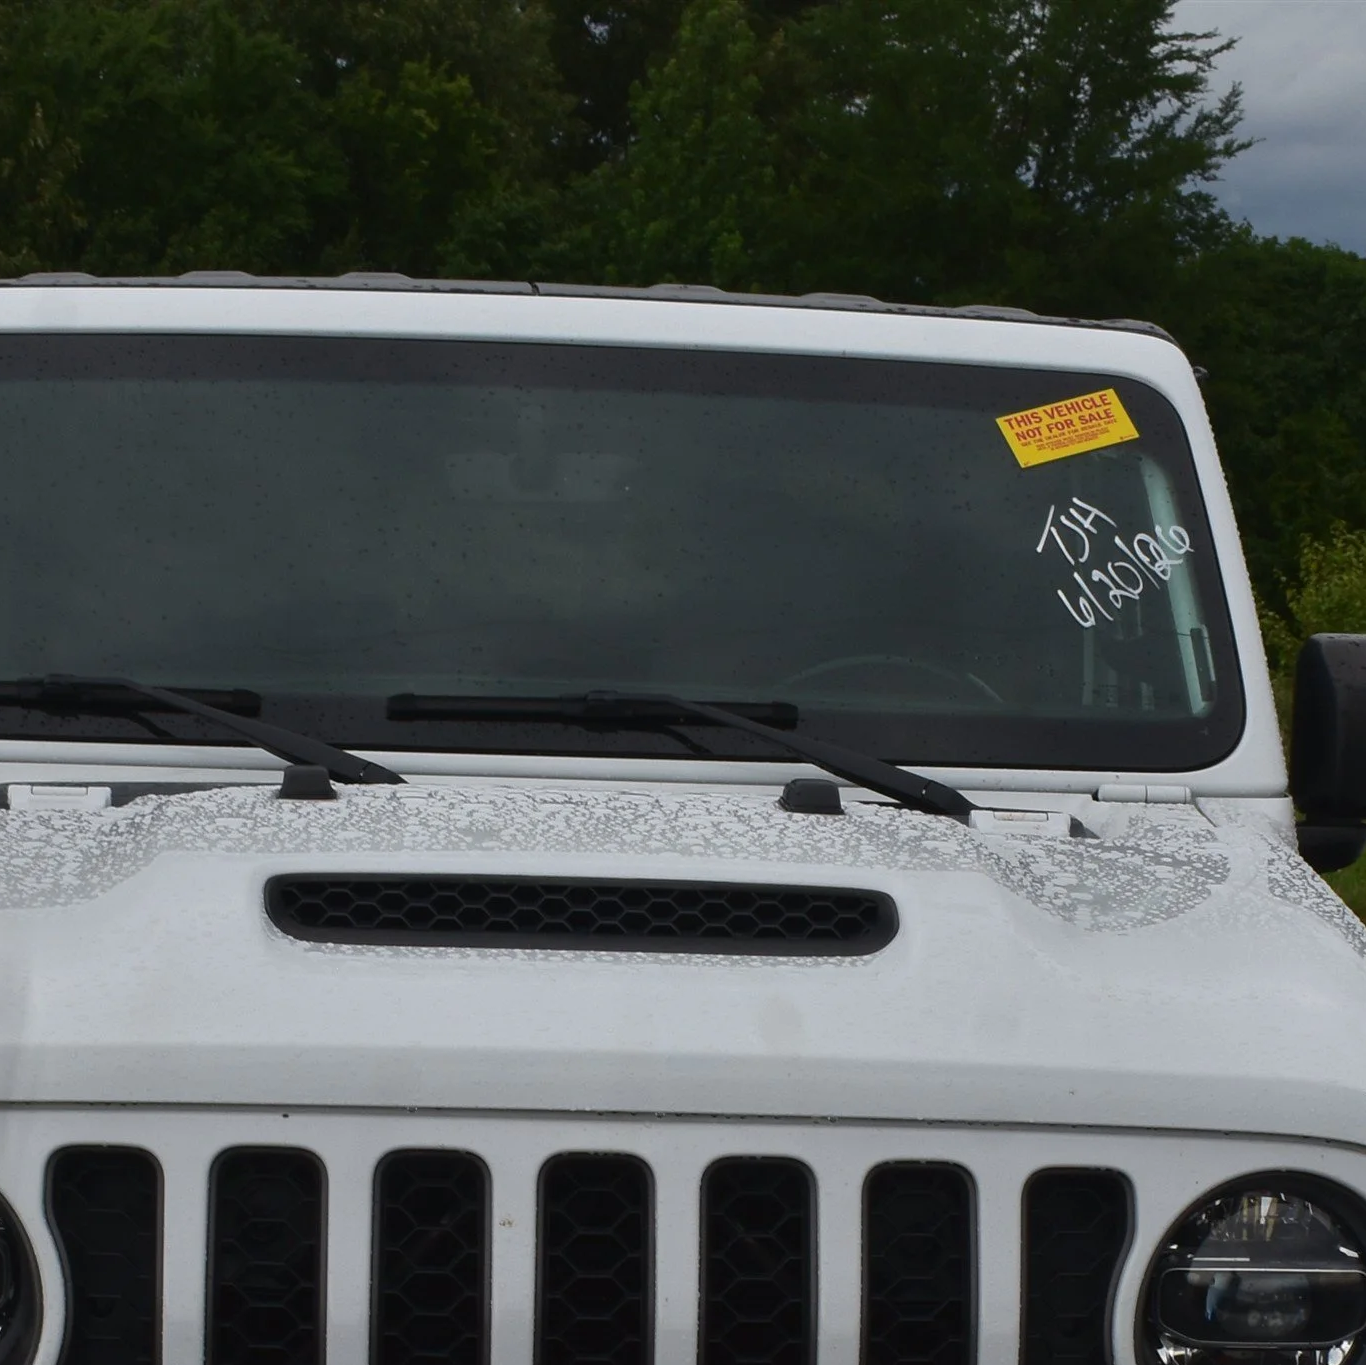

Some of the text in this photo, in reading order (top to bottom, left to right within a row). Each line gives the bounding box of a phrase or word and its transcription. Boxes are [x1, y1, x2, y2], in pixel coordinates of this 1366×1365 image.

[1003, 393, 1112, 431] THIS VEHICLE
[1014, 426, 1044, 441] NOT
[1045, 417, 1076, 433] FOR
[1076, 407, 1114, 425] SALE
